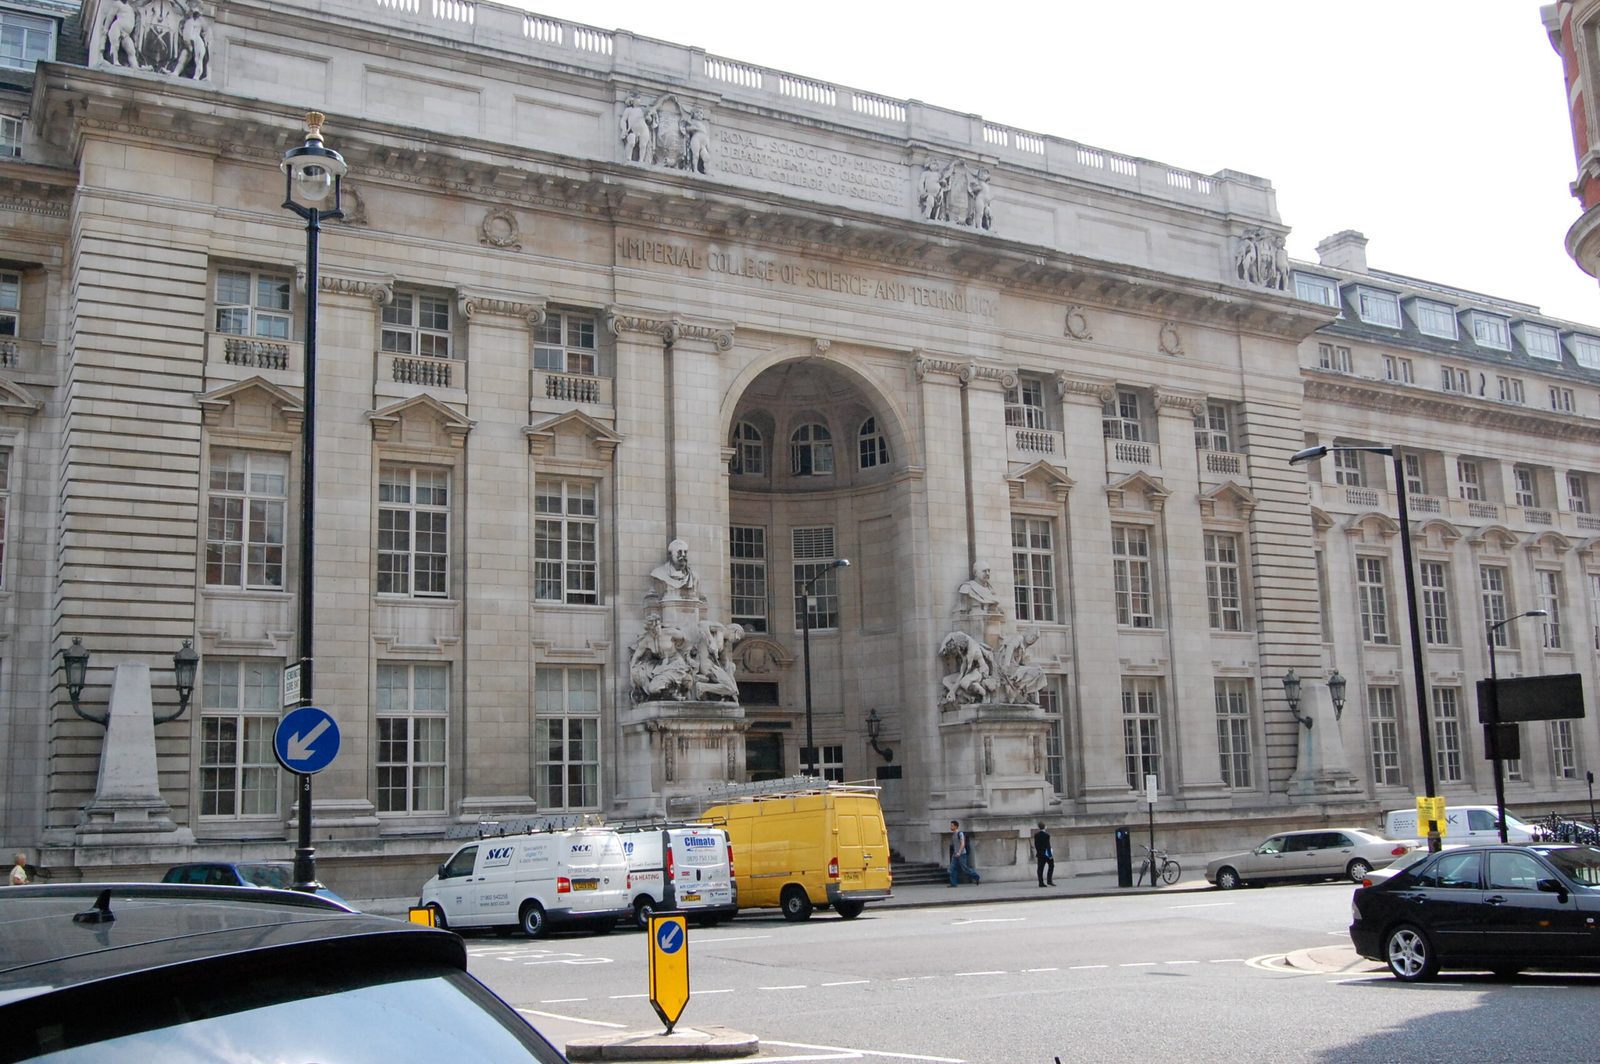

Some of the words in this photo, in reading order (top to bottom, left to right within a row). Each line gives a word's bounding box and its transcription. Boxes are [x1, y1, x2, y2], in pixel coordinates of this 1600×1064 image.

[720, 130, 764, 150] ROYAL
[770, 142, 824, 163] SCHOOL
[829, 153, 847, 167] OF
[854, 158, 897, 178] MINES
[720, 145, 807, 174] DEPARTMENT
[815, 165, 833, 178] OF
[839, 170, 897, 192] GEOLOGY
[720, 160, 764, 179] ROYAL
[769, 170, 824, 191] COLLEGE
[827, 182, 847, 195] OF
[849, 185, 901, 206] SCIENCE
[622, 236, 702, 270] IMPERIAL
[707, 251, 774, 281] COLLEGE
[780, 264, 801, 285] OF
[806, 267, 868, 296] SCIENCE
[874, 280, 906, 303] AND
[912, 286, 993, 317] TECHNOLOGY
[486, 846, 513, 860] SCC
[571, 844, 591, 853] SCC
[684, 836, 715, 847] Climate
